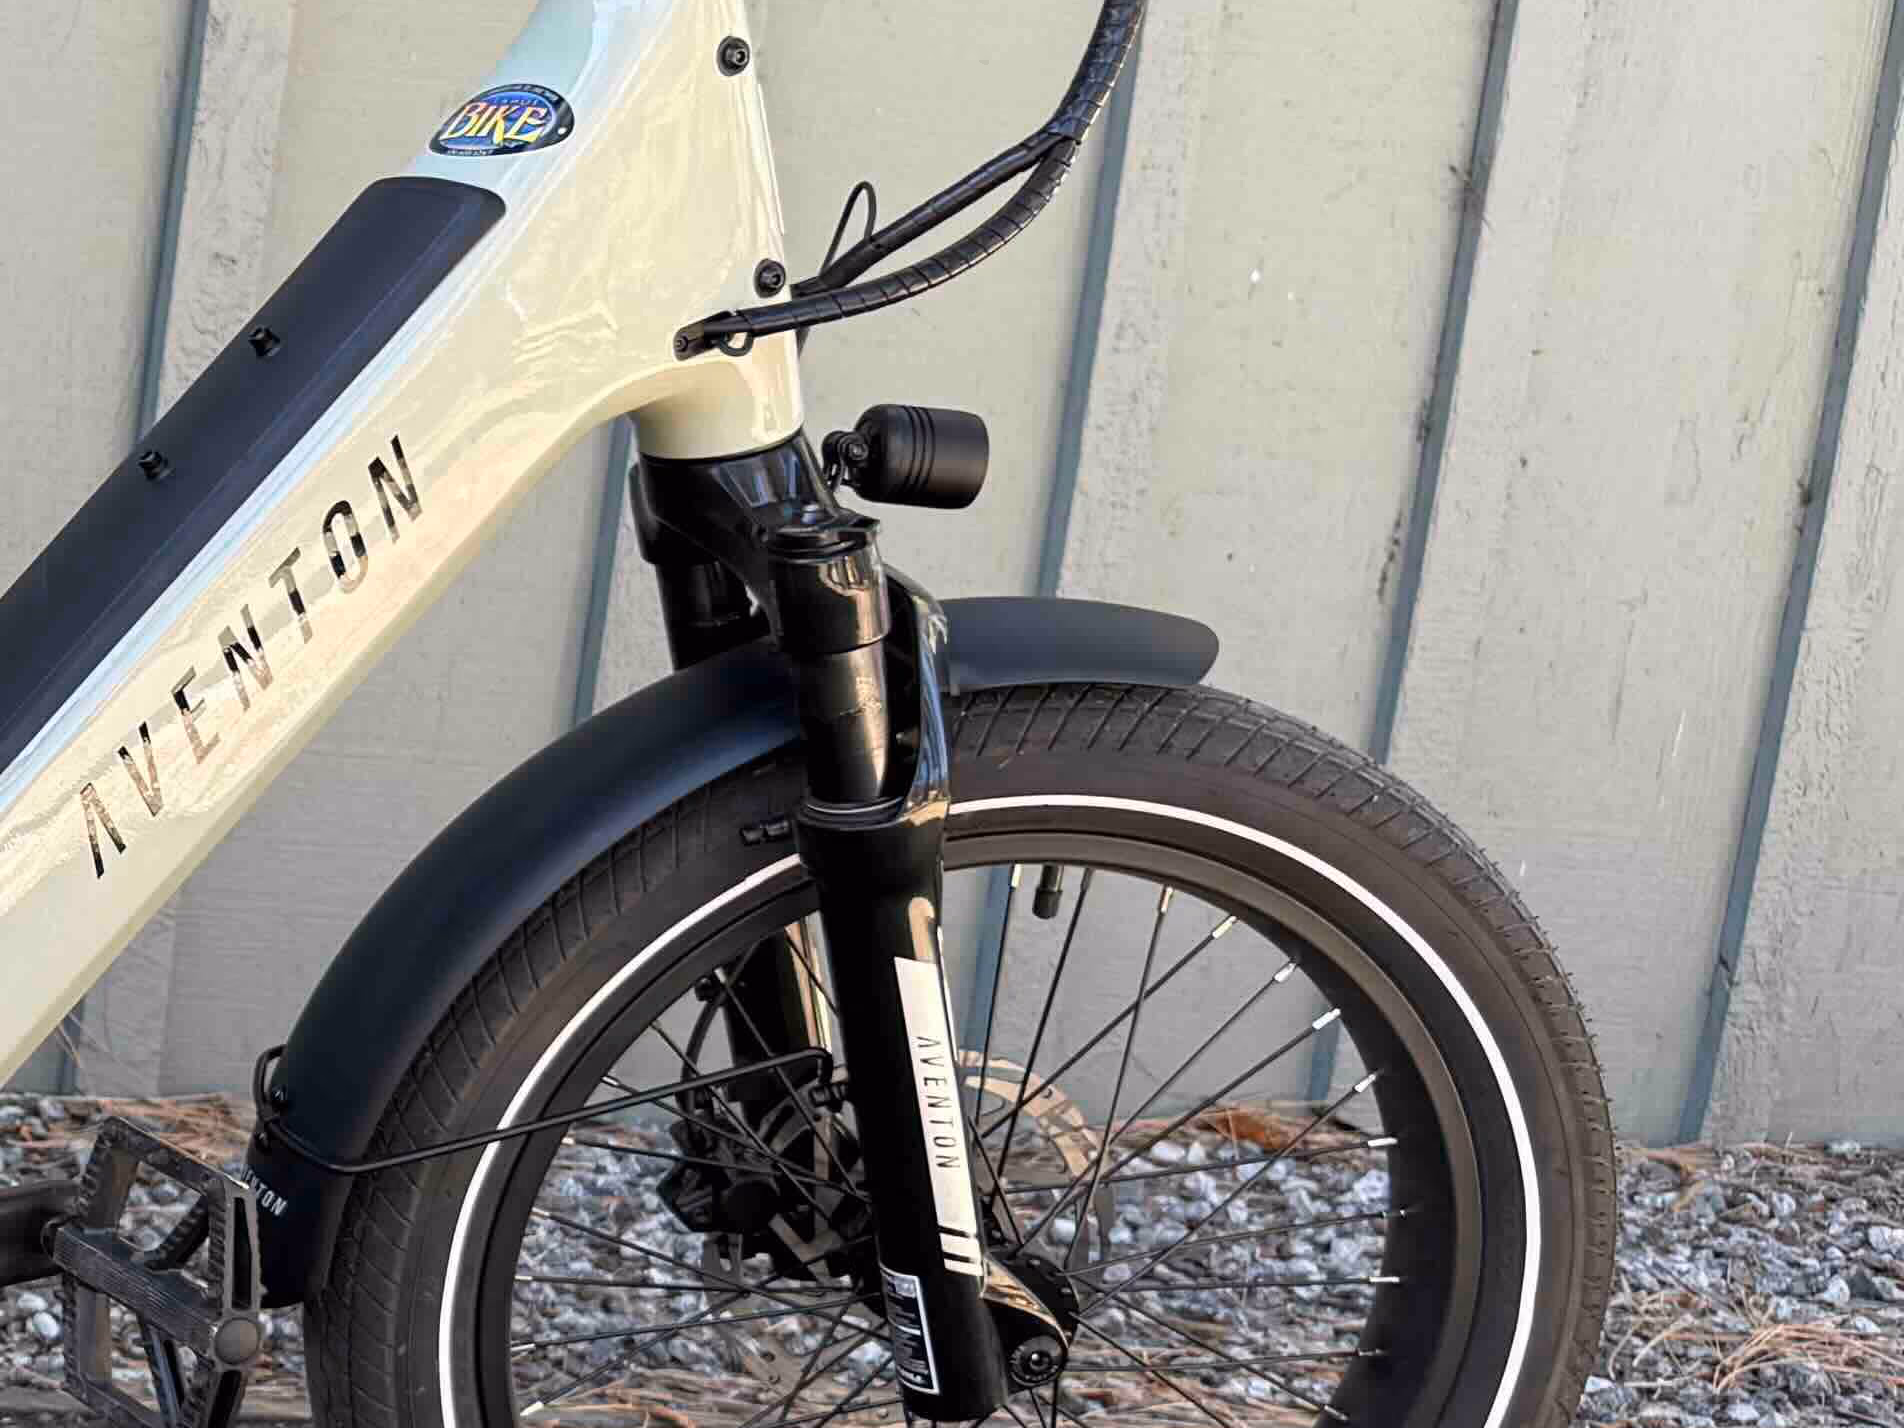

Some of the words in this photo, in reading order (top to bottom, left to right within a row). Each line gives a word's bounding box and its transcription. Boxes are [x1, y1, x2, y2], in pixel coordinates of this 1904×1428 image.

[438, 101, 548, 147] BIKE
[79, 434, 423, 879] AVENTON
[916, 1036, 961, 1169] AVENTON
